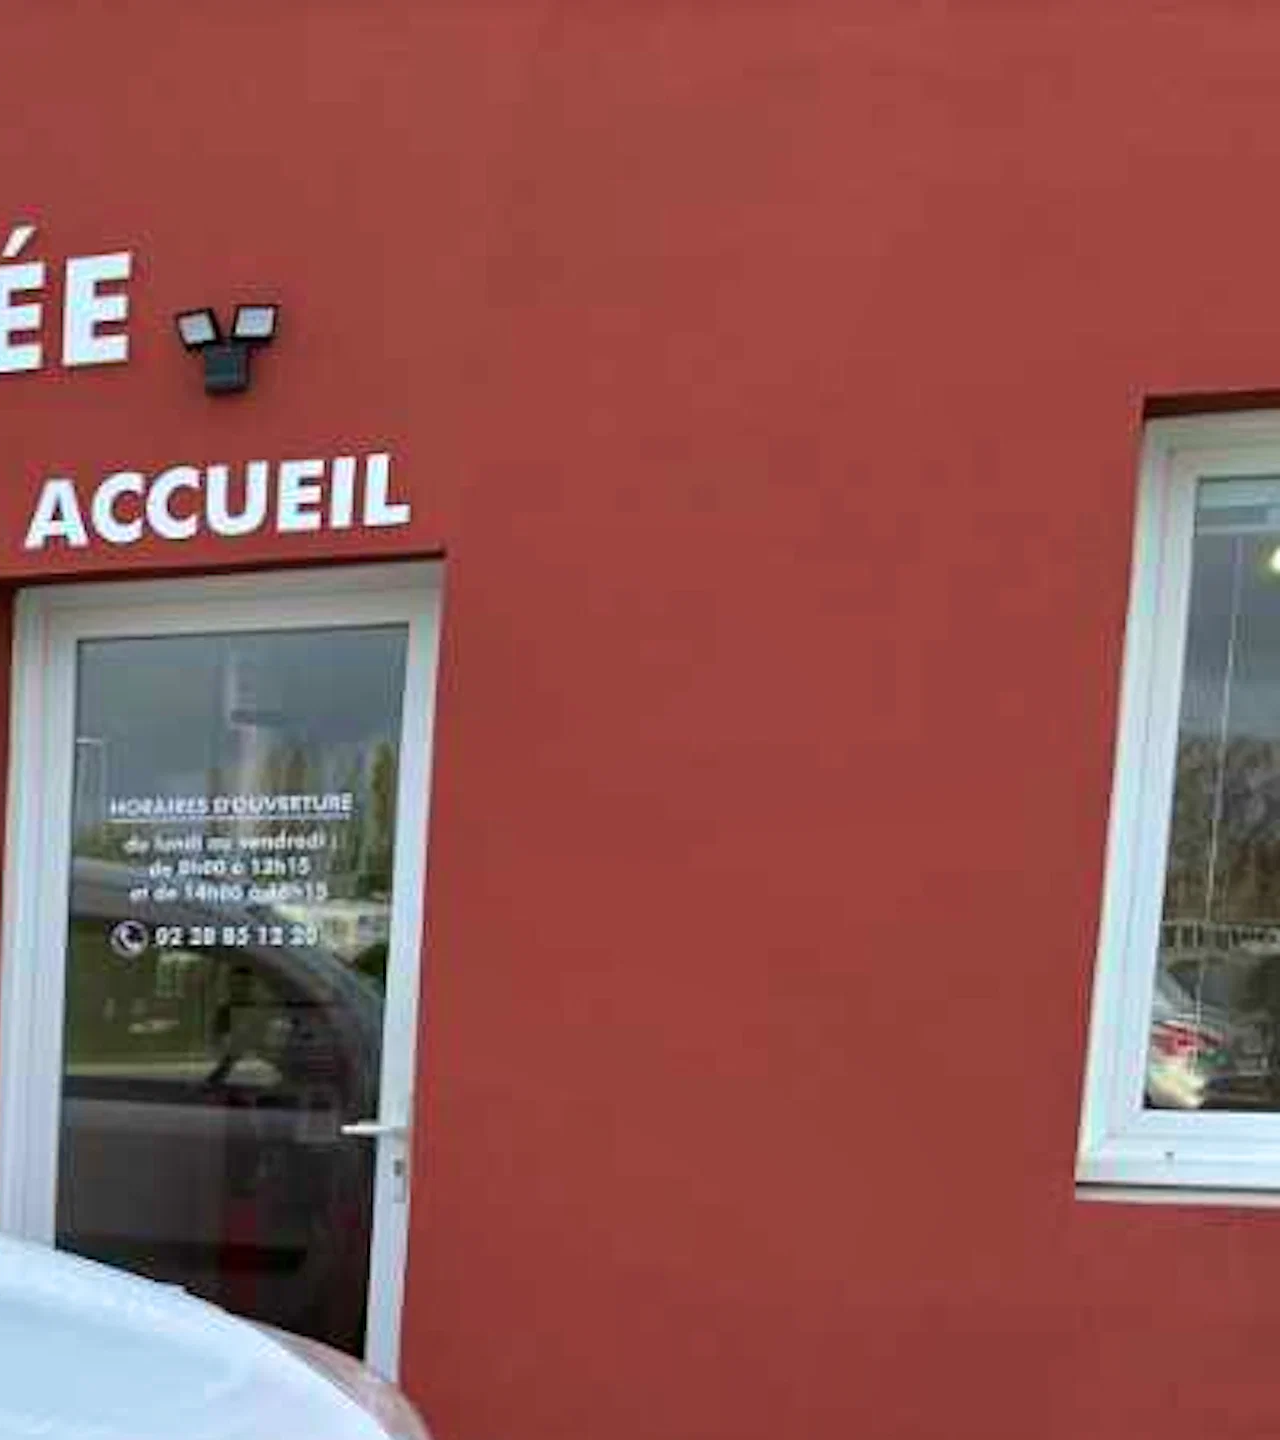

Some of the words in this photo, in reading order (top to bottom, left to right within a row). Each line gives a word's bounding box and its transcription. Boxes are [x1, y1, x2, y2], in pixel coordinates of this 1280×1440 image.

[24, 452, 412, 550] ACCUEIL
[110, 794, 207, 815] HORAIRES
[212, 792, 354, 814] D'OUVERTURE
[239, 828, 326, 851] vendredi
[155, 925, 184, 947] 02
